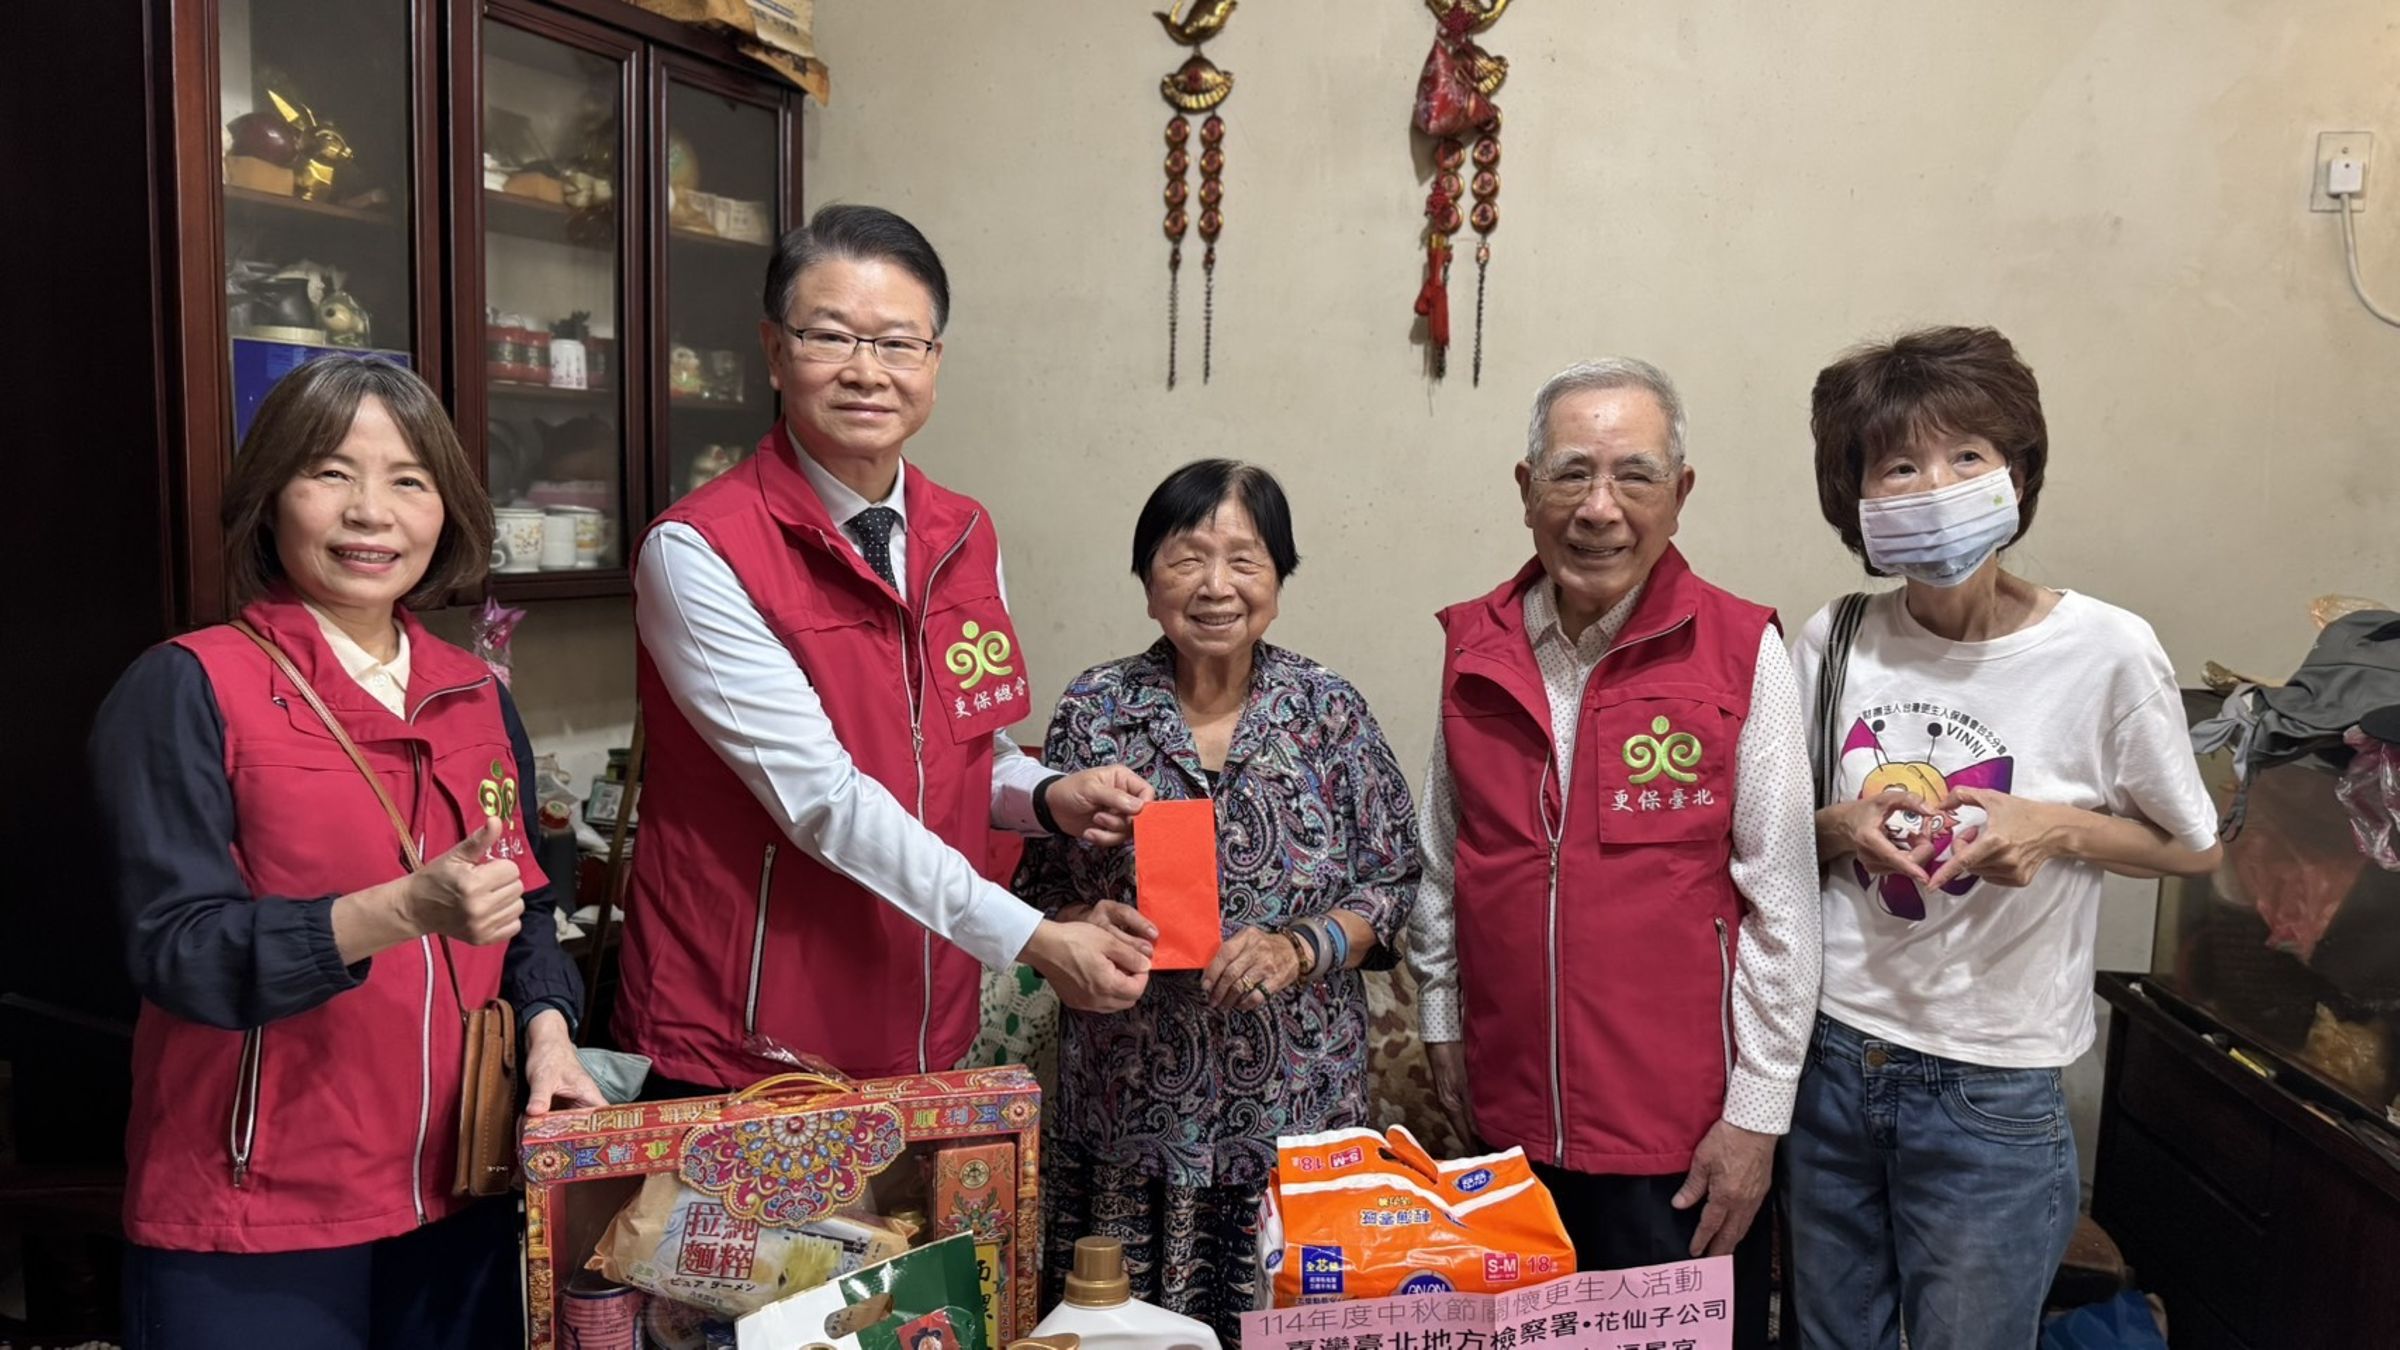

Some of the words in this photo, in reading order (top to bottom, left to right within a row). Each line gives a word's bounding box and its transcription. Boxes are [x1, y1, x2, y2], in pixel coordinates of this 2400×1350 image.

[1946, 723, 1986, 758] VINNI
[1610, 788, 1715, 812] 更保臺北
[1301, 1157, 1322, 1171] 18
[1488, 1259, 1516, 1273] S-M
[1528, 1256, 1550, 1273] 18
